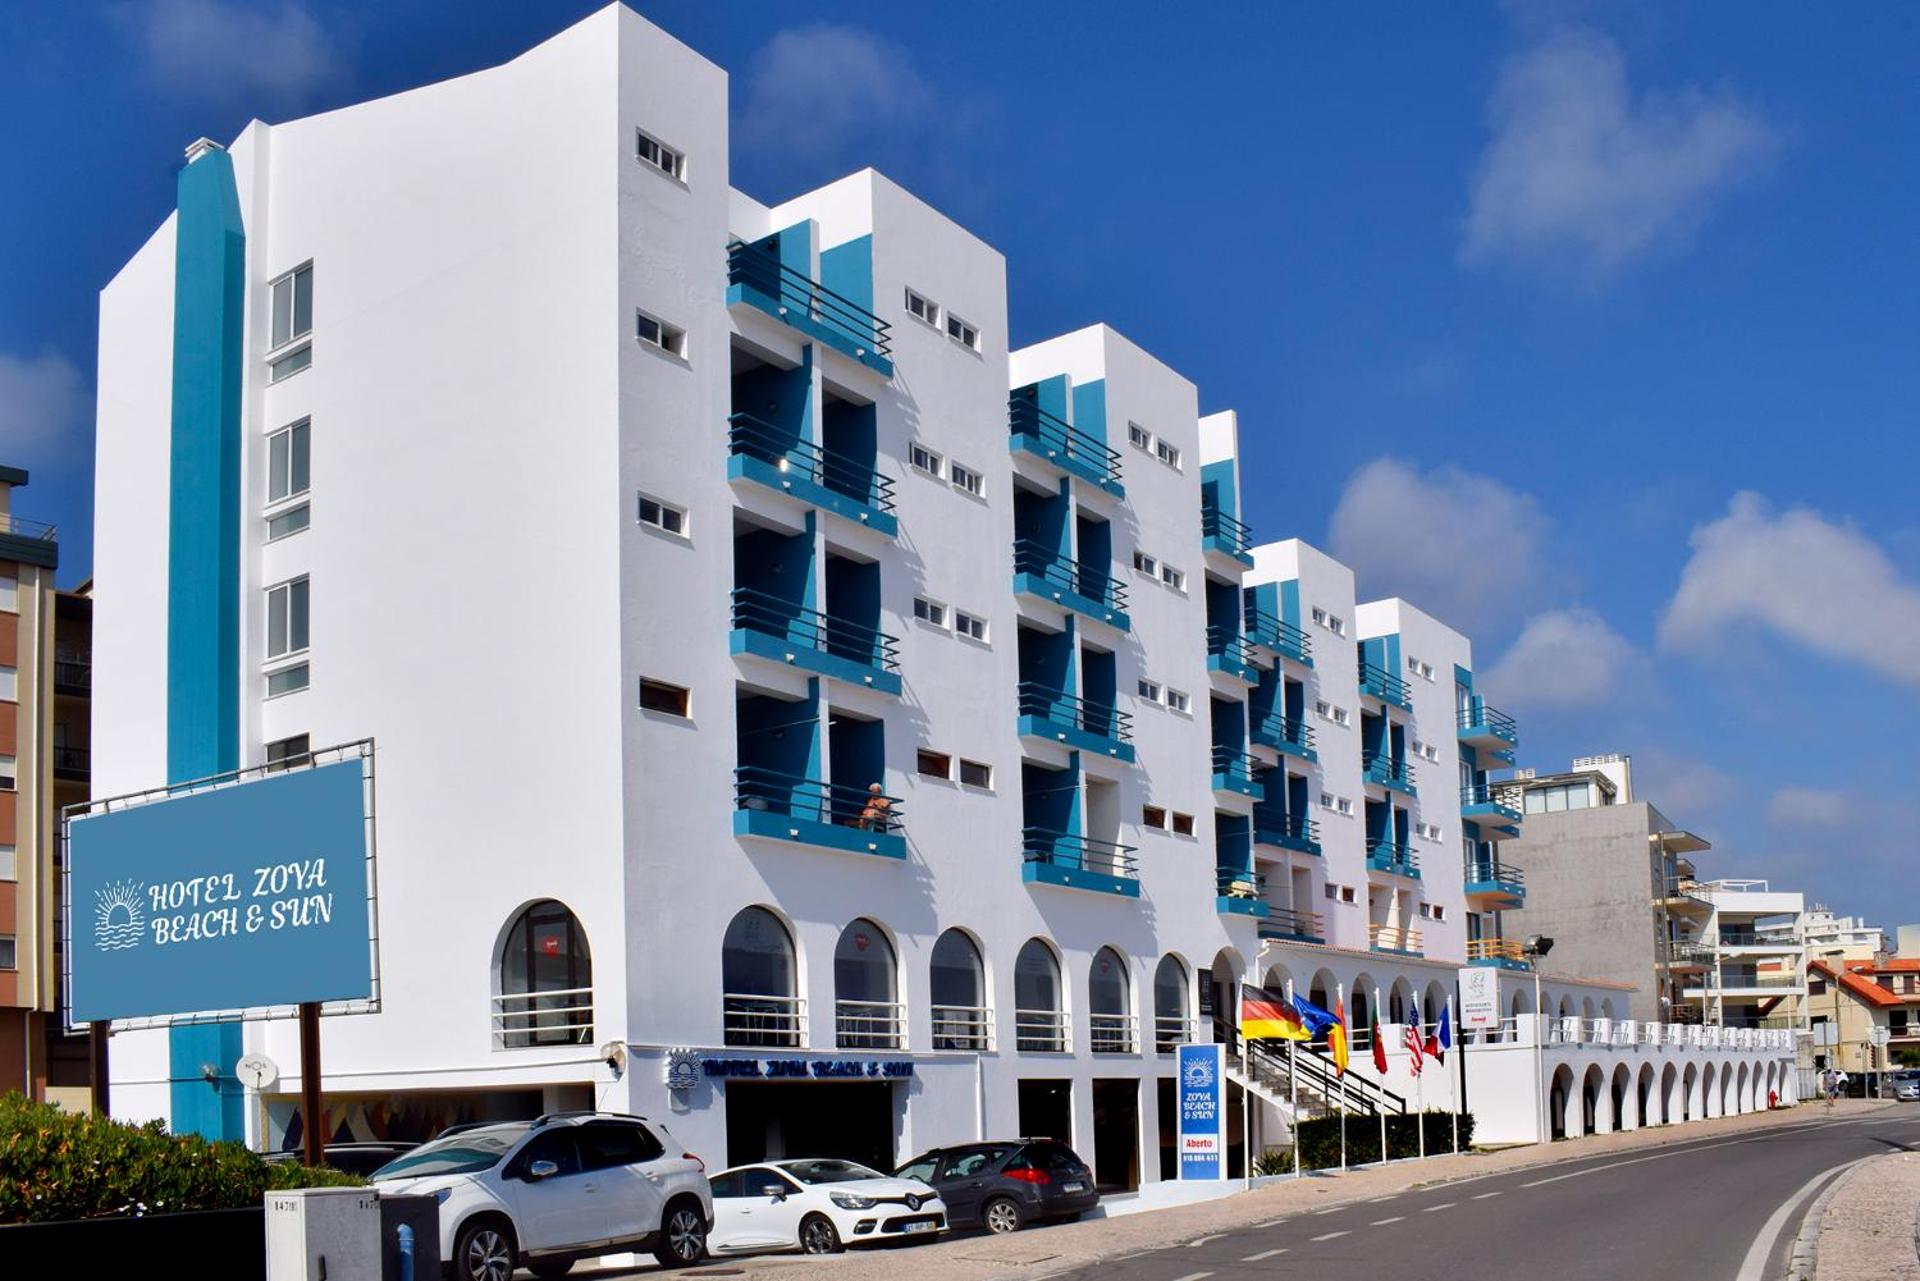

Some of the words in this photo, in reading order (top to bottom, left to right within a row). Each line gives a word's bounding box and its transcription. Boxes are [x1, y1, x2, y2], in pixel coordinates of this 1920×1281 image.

[148, 872, 241, 912] HOTEL
[252, 858, 327, 897] ZOYA
[151, 908, 238, 945] BEACH
[245, 904, 265, 934] &
[270, 892, 334, 931] SUN
[1186, 1092, 1211, 1102] ZOYA
[1183, 1101, 1216, 1111] BEACH
[1184, 1111, 1191, 1120] &
[1192, 1110, 1214, 1120] SUN
[1186, 1139, 1213, 1148] Aberto
